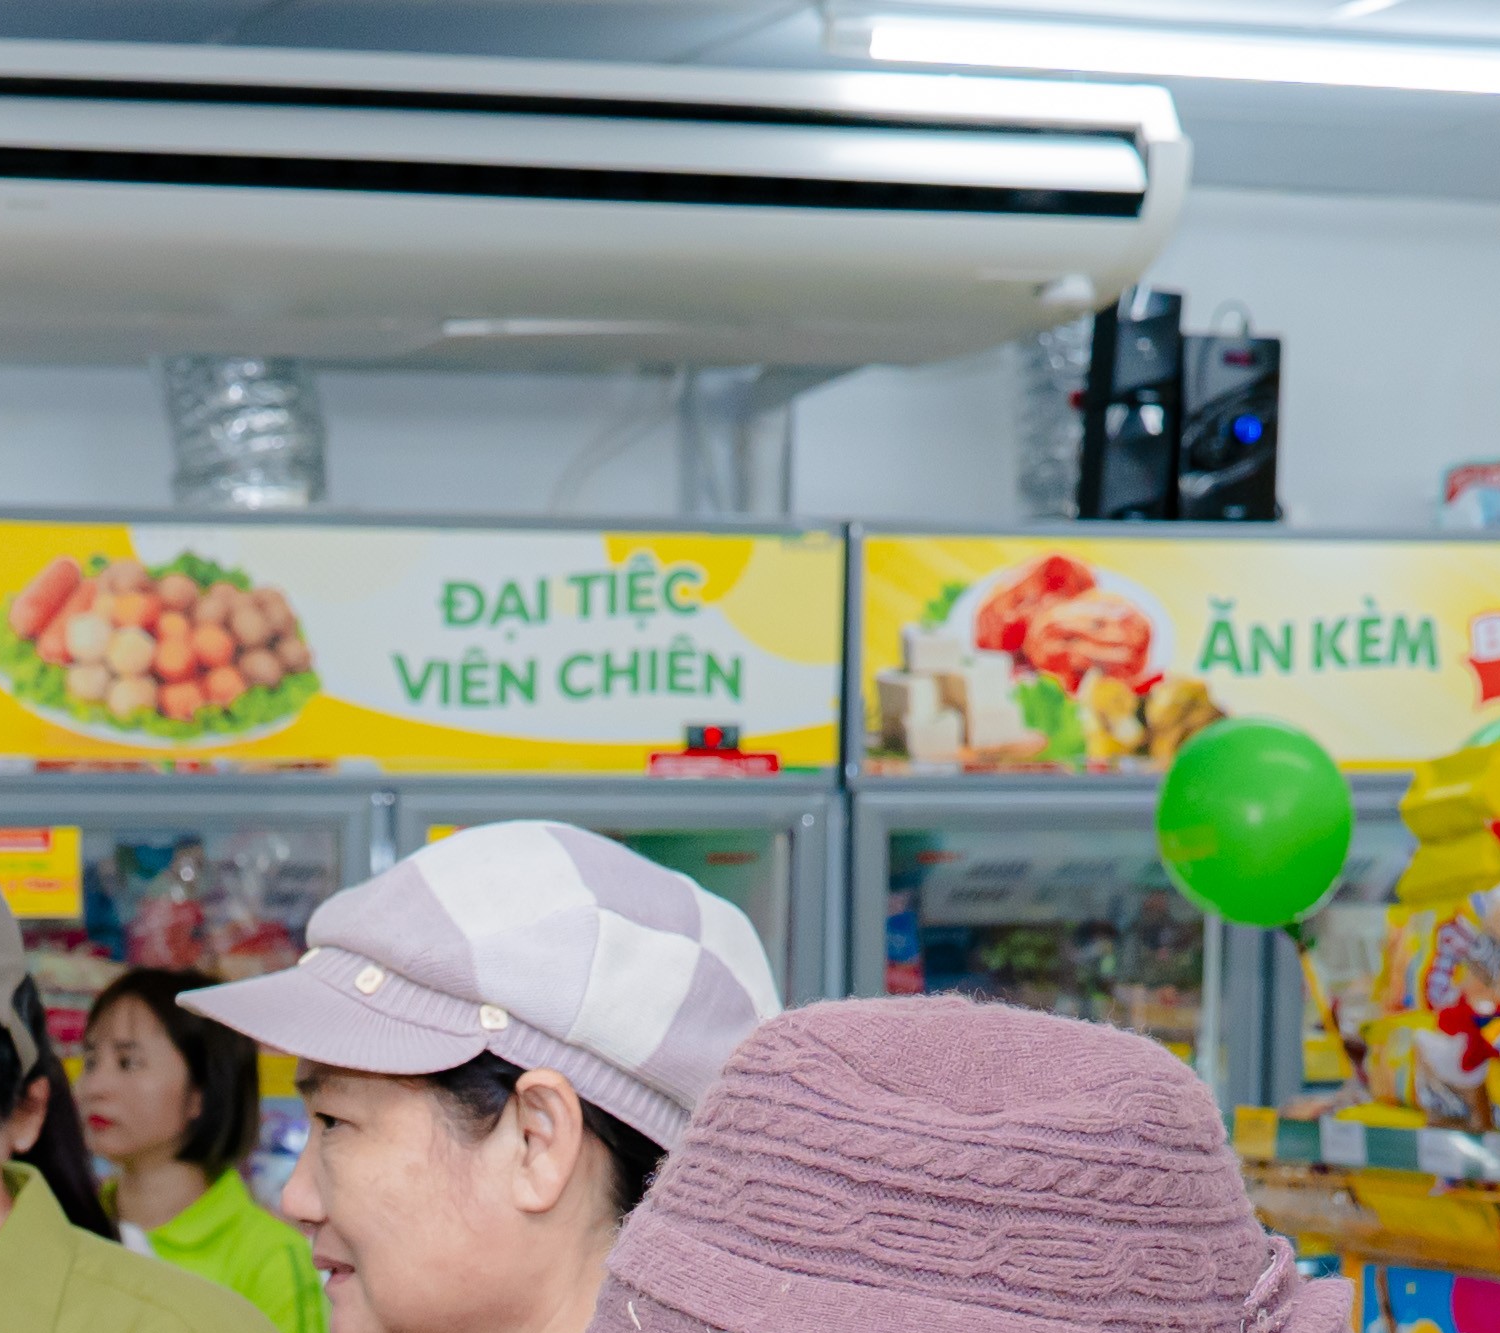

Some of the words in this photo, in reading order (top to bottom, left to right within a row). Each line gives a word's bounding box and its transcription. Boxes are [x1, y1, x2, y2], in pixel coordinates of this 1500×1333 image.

[440, 577, 550, 642] ĐẠI
[567, 552, 702, 630] TIỆC
[1197, 596, 1294, 675] ĂN
[1311, 595, 1439, 670] KÈM
[391, 647, 538, 707] VIÊN
[558, 633, 744, 701] CHIÊN
